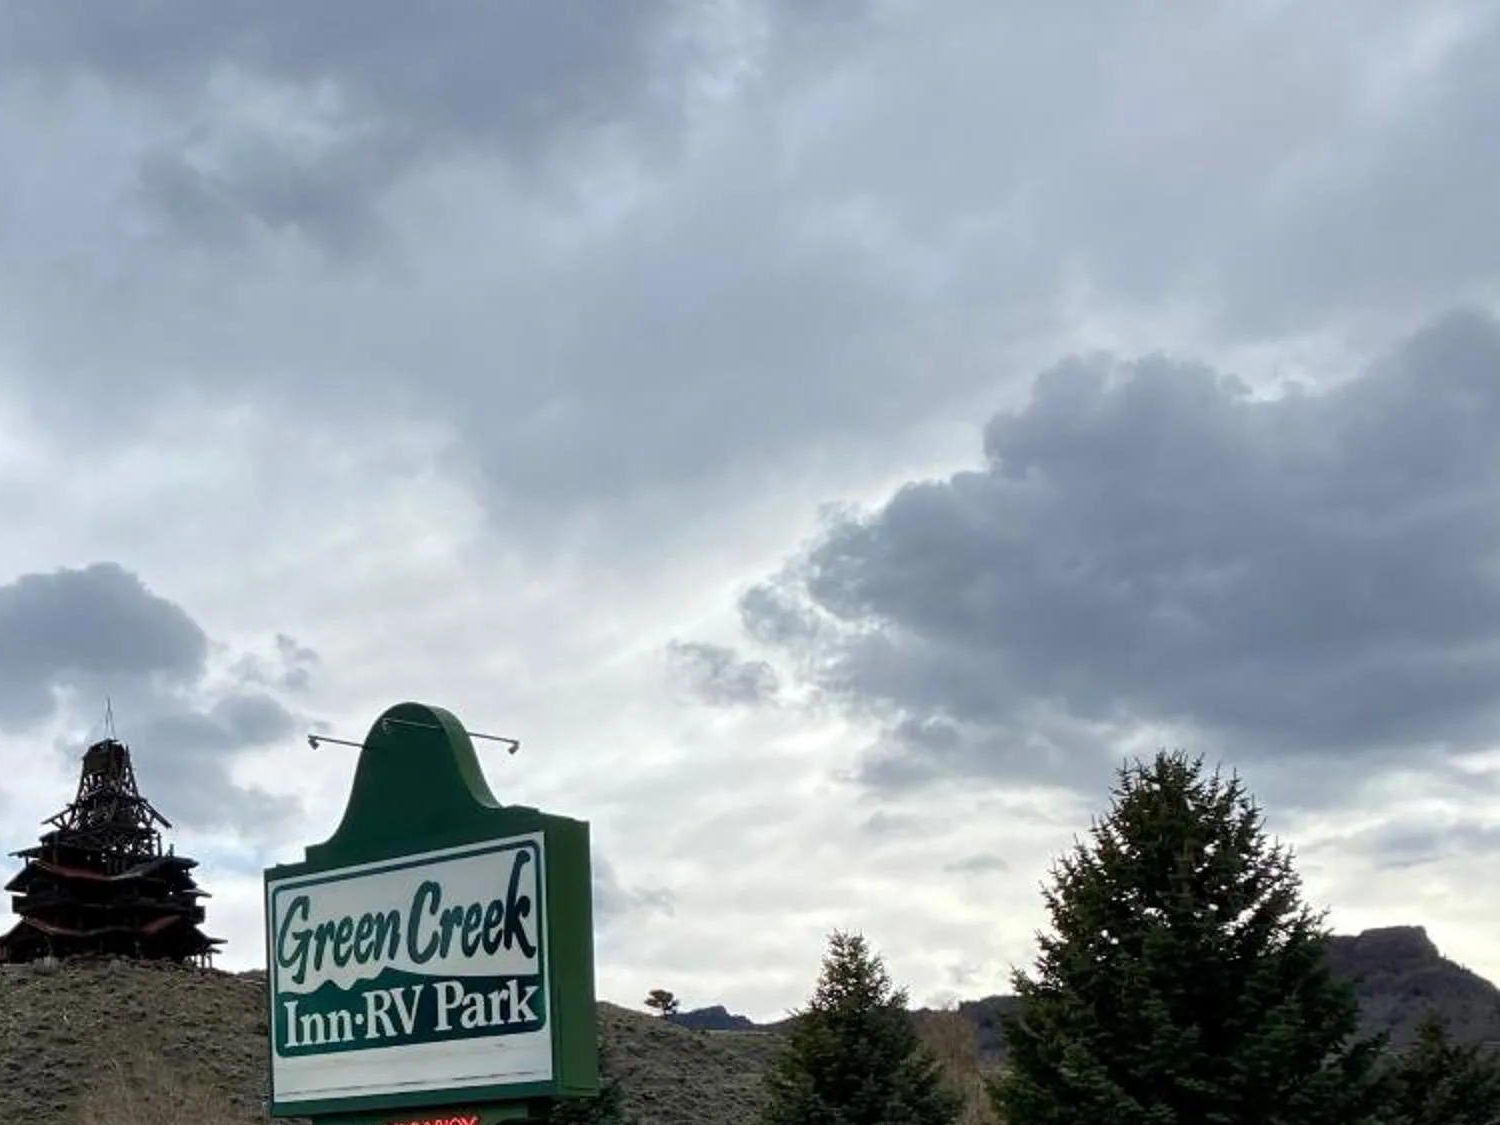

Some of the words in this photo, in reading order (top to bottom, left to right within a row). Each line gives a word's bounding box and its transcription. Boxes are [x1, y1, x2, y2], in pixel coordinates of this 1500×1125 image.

[277, 895, 401, 984] Green
[407, 849, 537, 964] Creek
[434, 979, 538, 1032] Park
